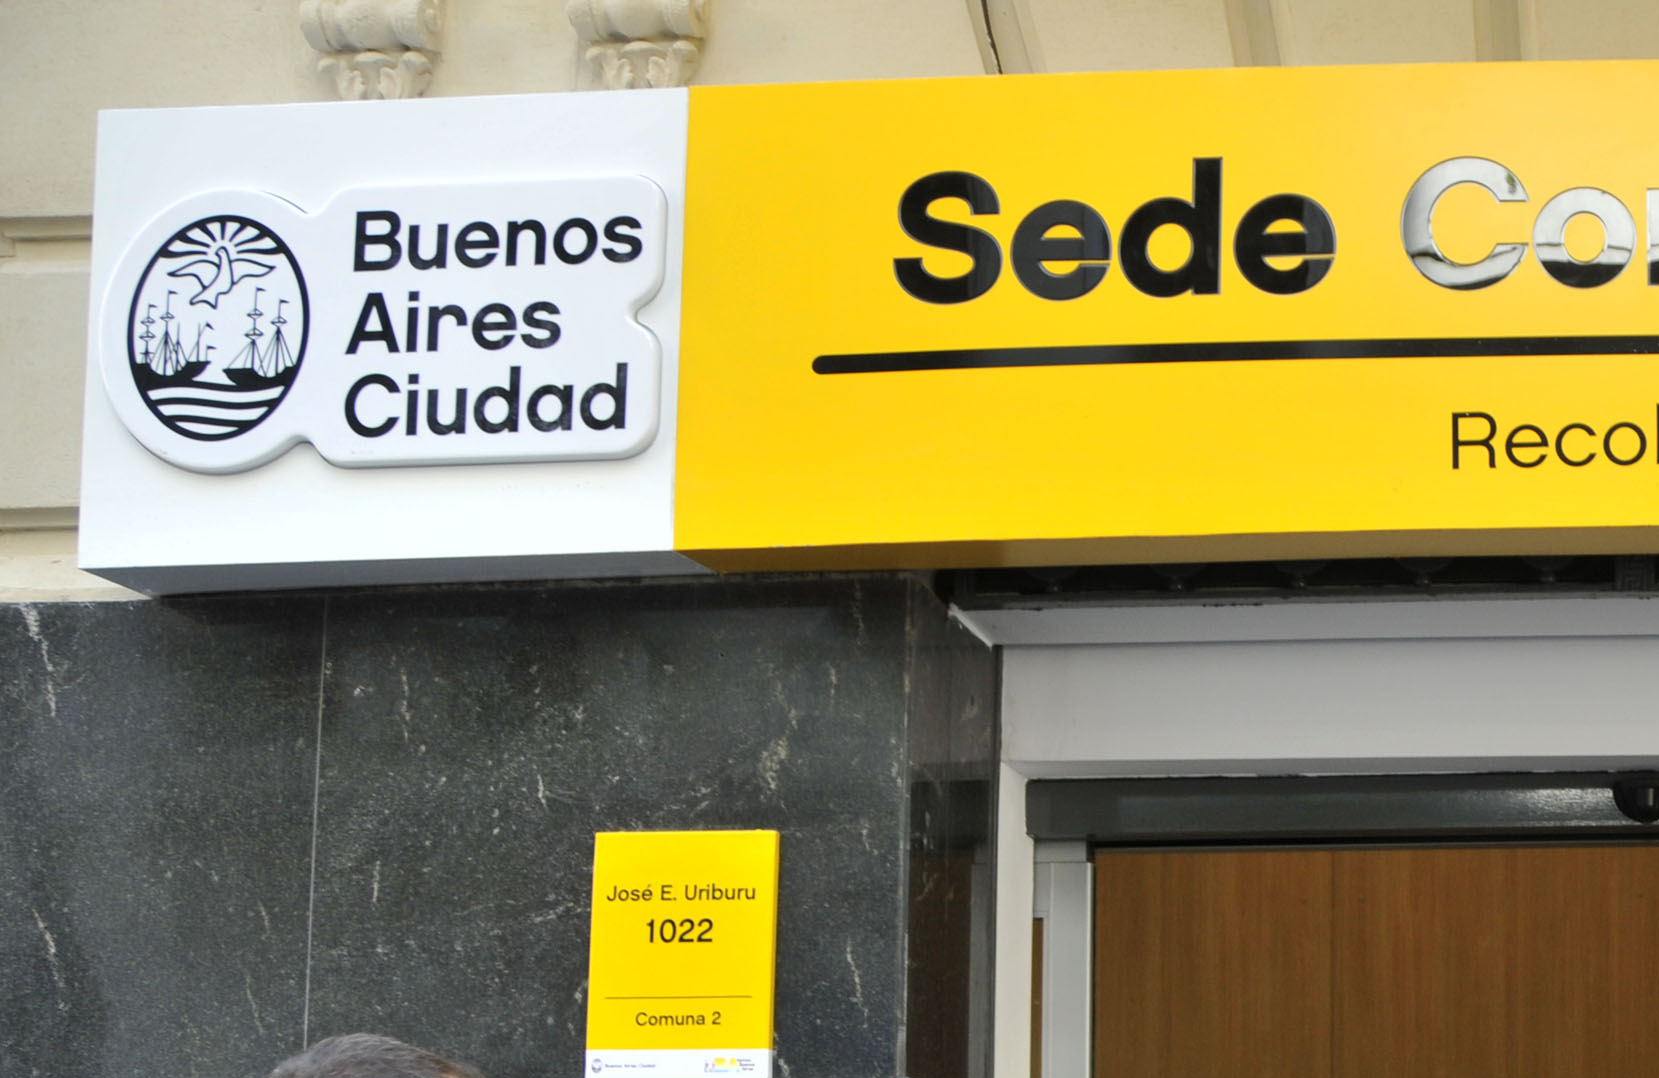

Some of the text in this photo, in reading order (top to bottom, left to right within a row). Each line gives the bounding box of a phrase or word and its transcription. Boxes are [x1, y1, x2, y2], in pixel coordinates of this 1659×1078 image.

[353, 210, 644, 272] Buenos
[892, 157, 1337, 305] Sede
[345, 291, 562, 355] Aires
[343, 362, 628, 438] Ciudad
[606, 883, 757, 902] José E. Uriburu
[646, 918, 714, 944] 1022
[635, 1010, 722, 1027] Comuna 2
